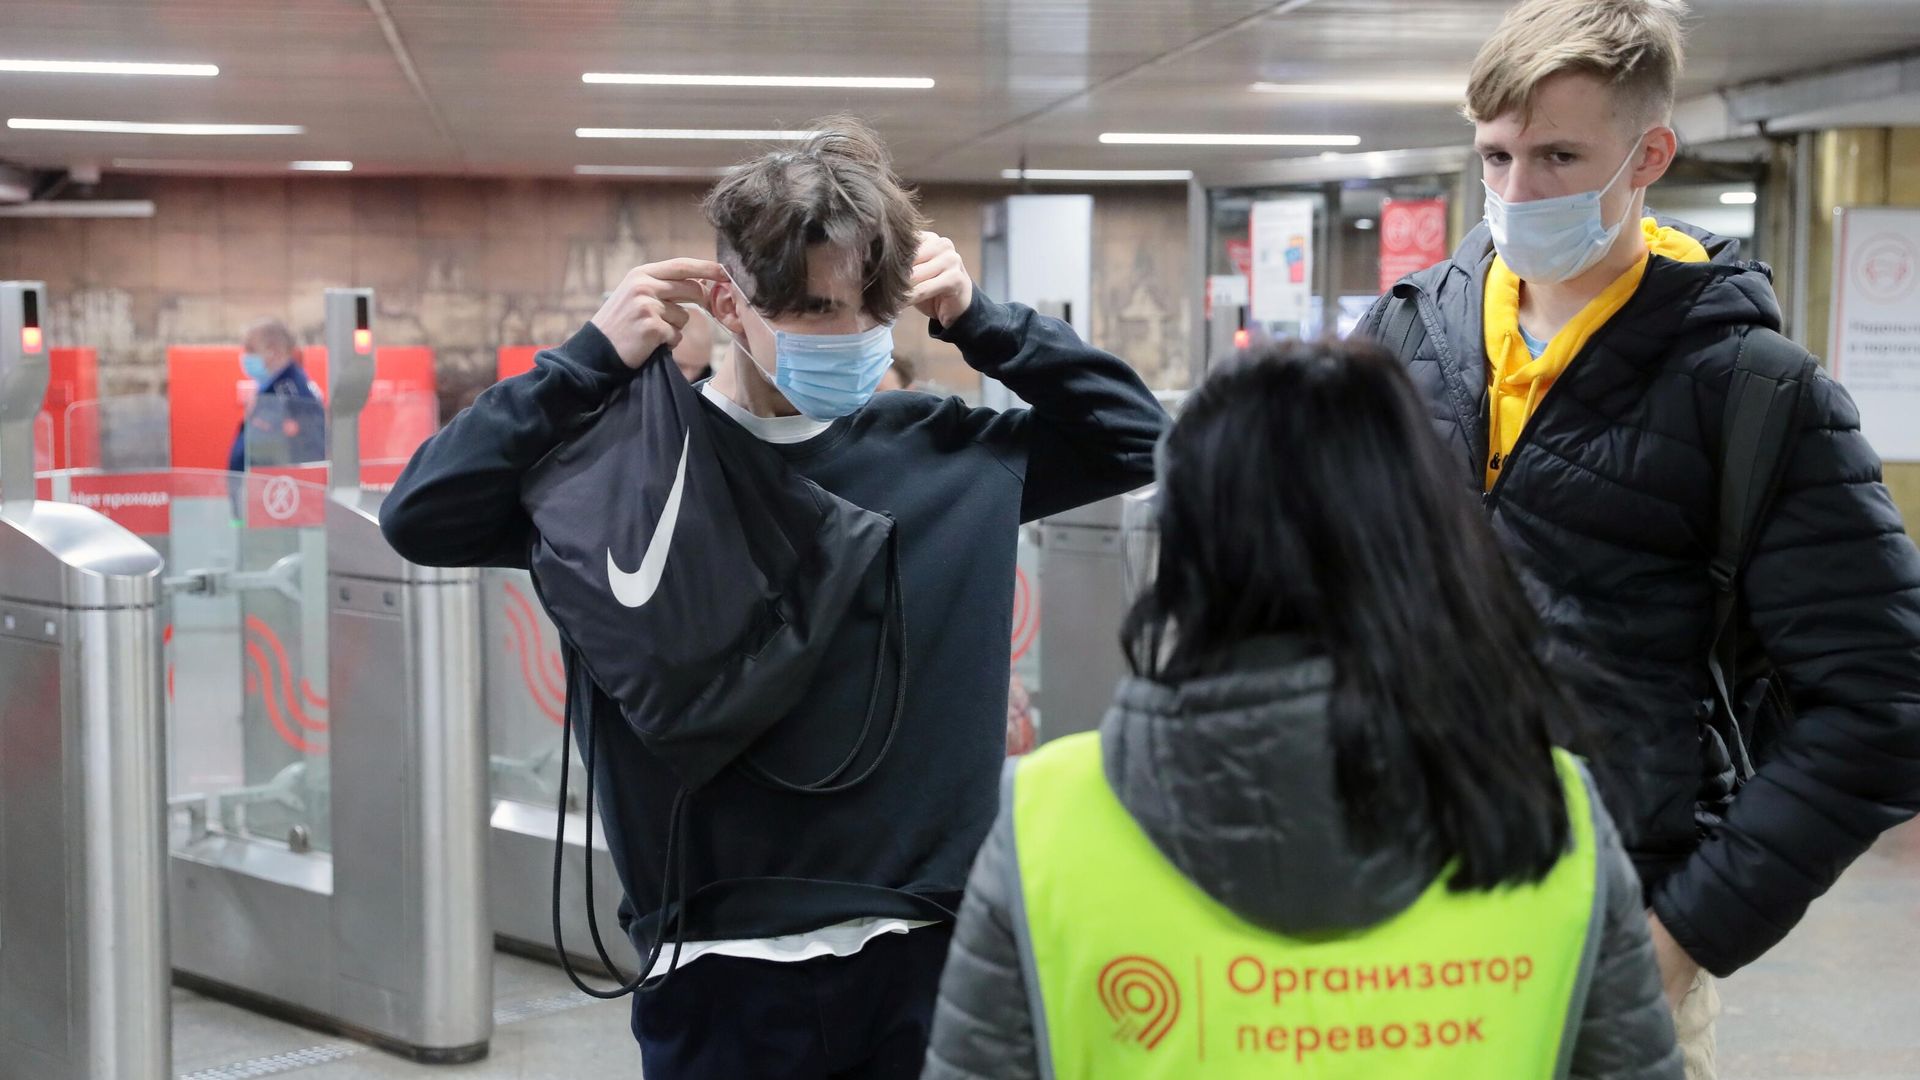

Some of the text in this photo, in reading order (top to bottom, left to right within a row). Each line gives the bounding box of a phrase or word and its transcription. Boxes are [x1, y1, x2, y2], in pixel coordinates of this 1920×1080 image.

[102, 491, 169, 509] прохода
[1227, 954, 1534, 1005] Организатор
[1237, 1018, 1485, 1063] перевозок
